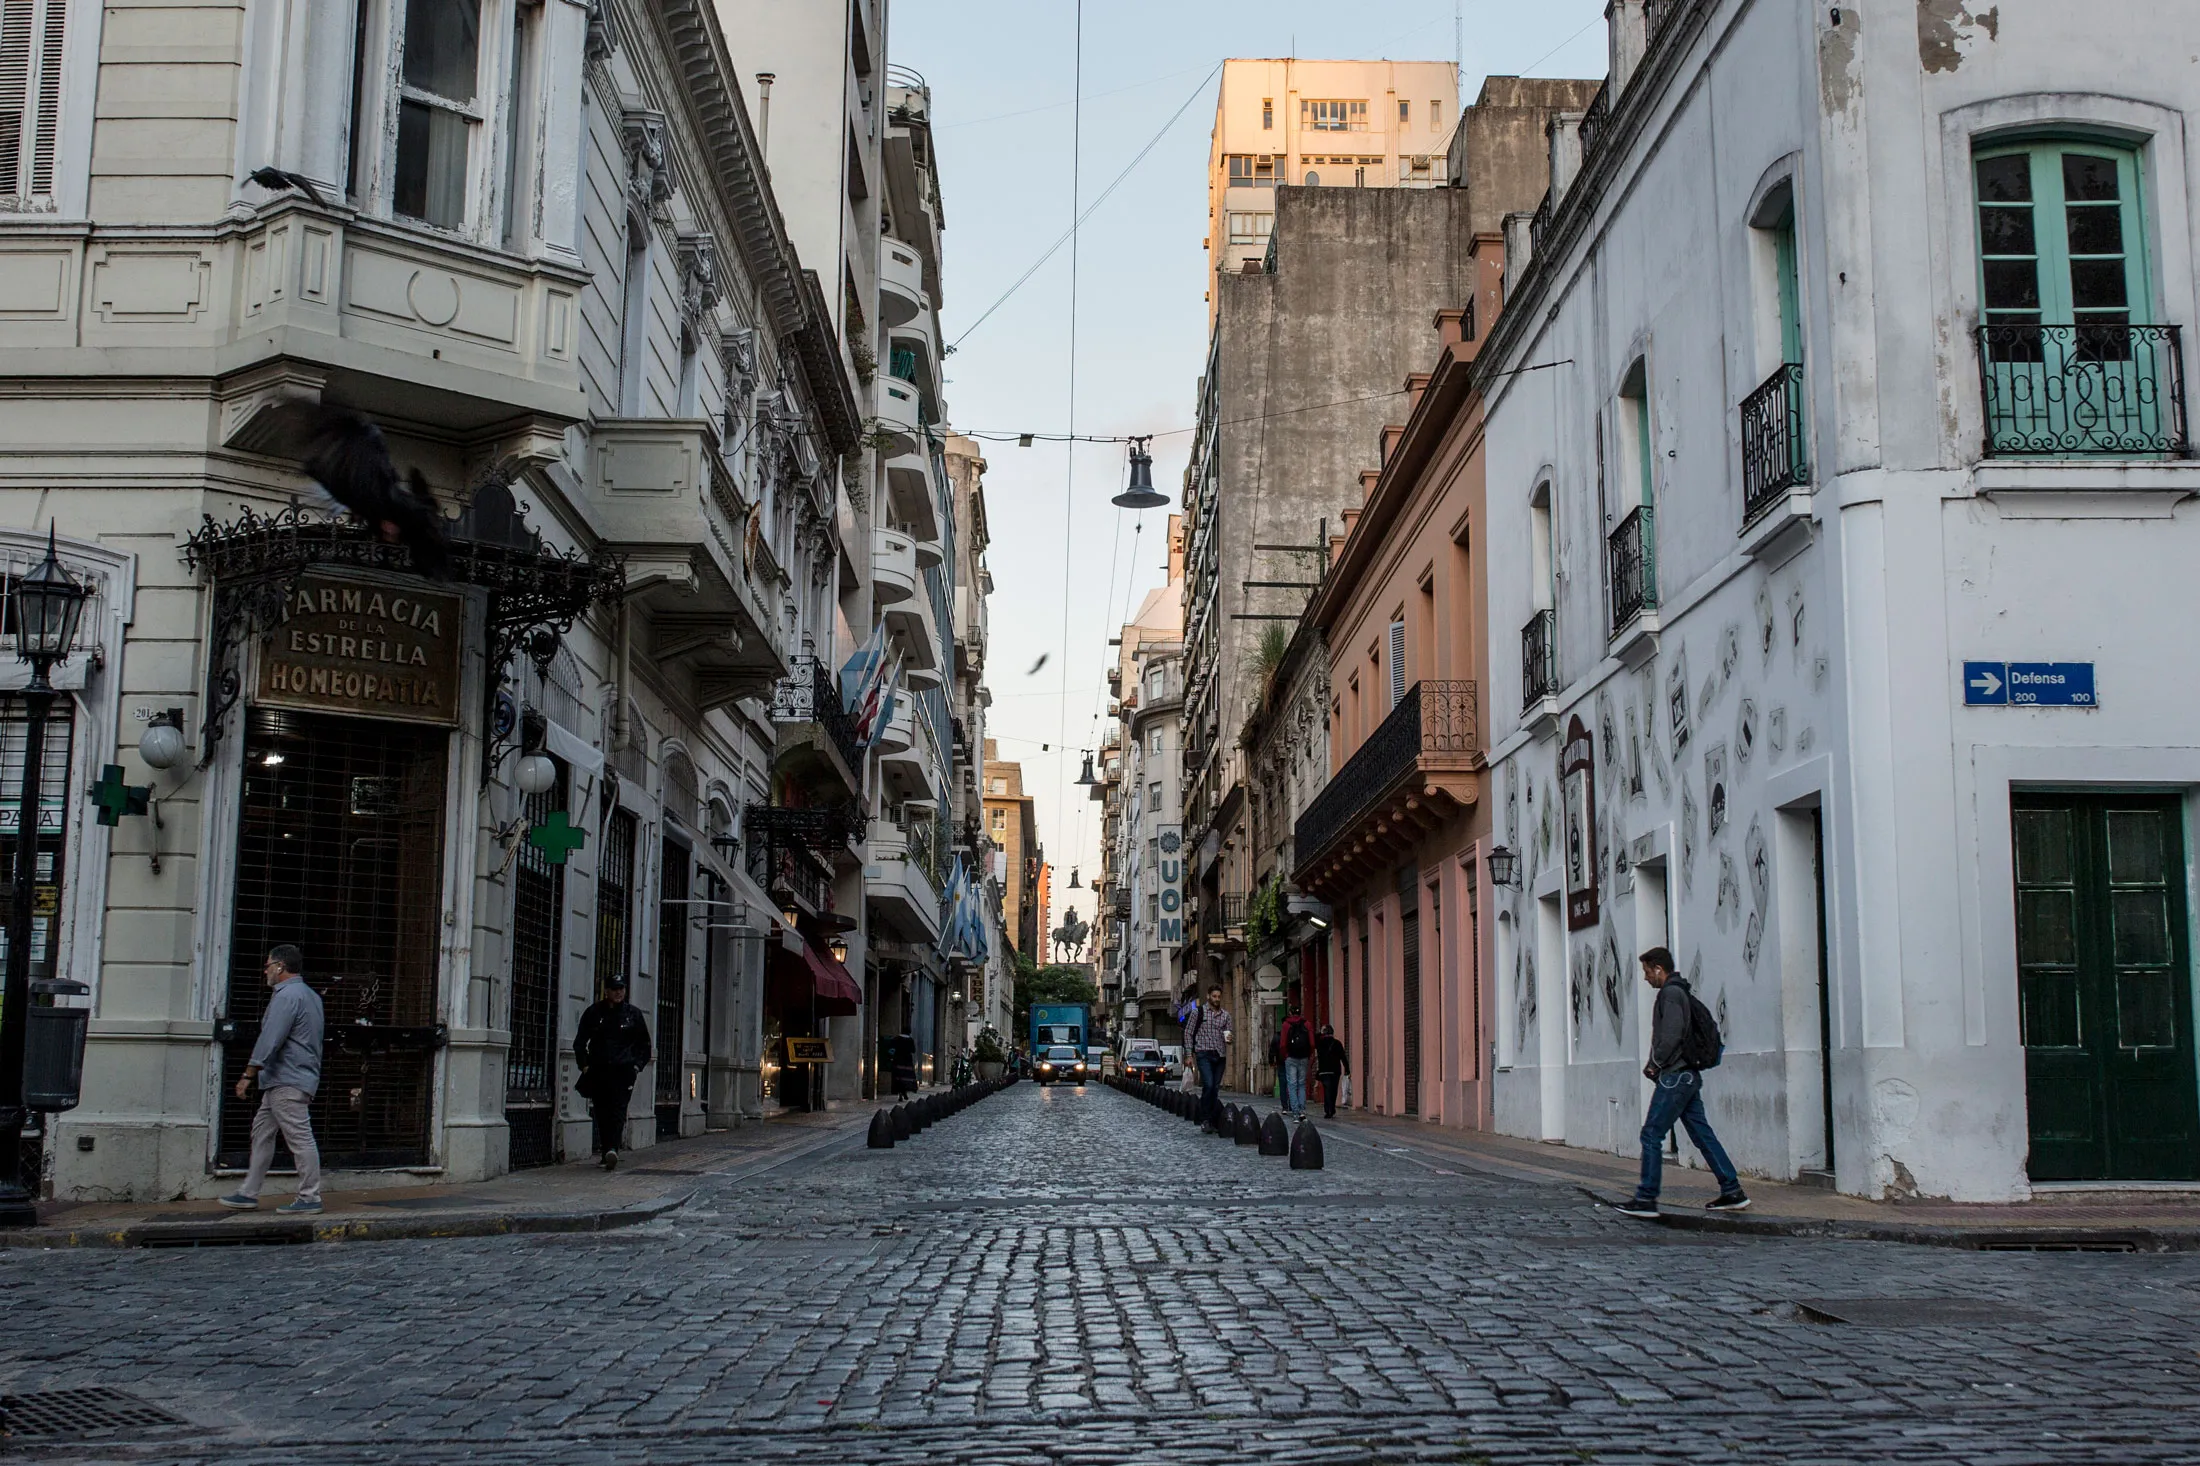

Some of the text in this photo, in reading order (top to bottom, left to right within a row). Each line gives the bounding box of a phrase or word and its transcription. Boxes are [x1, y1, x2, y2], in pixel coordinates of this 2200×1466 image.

[339, 619, 385, 635] DE LA
[290, 630, 427, 667] ESTRELLA
[270, 662, 441, 707] HOMEOPATIA
[2011, 672, 2066, 684] Defensa
[2015, 692, 2090, 702] 200 100
[136, 708, 150, 718] 201
[1160, 860, 1181, 942] UOM
